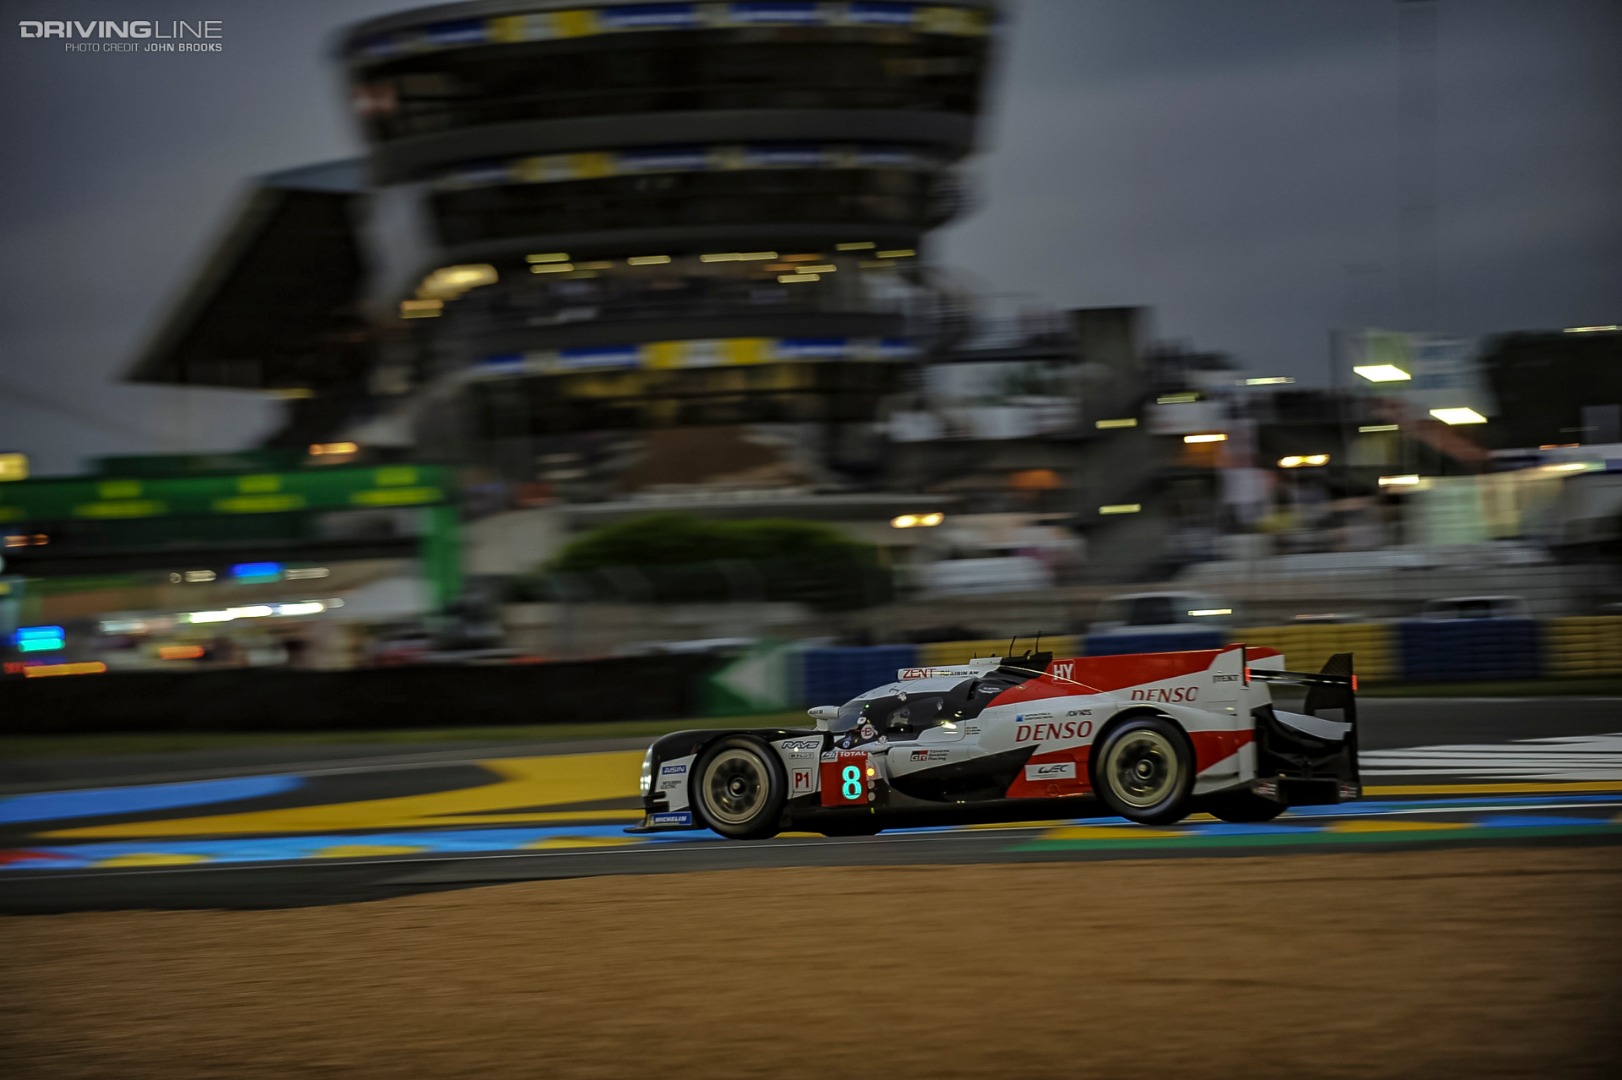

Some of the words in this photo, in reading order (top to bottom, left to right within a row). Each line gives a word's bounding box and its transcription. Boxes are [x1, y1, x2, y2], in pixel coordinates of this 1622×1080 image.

[902, 668, 936, 679] ZENT
[1053, 663, 1074, 681] HY
[1131, 686, 1199, 702] DENSO
[1015, 720, 1093, 742] DENSO
[782, 741, 820, 750] RAYS
[911, 753, 927, 761] GR
[663, 766, 686, 774] AISIN
[1038, 764, 1069, 774] WEC
[795, 772, 809, 789] P1
[841, 765, 862, 800] 8
[655, 815, 688, 823] MICHELIN
